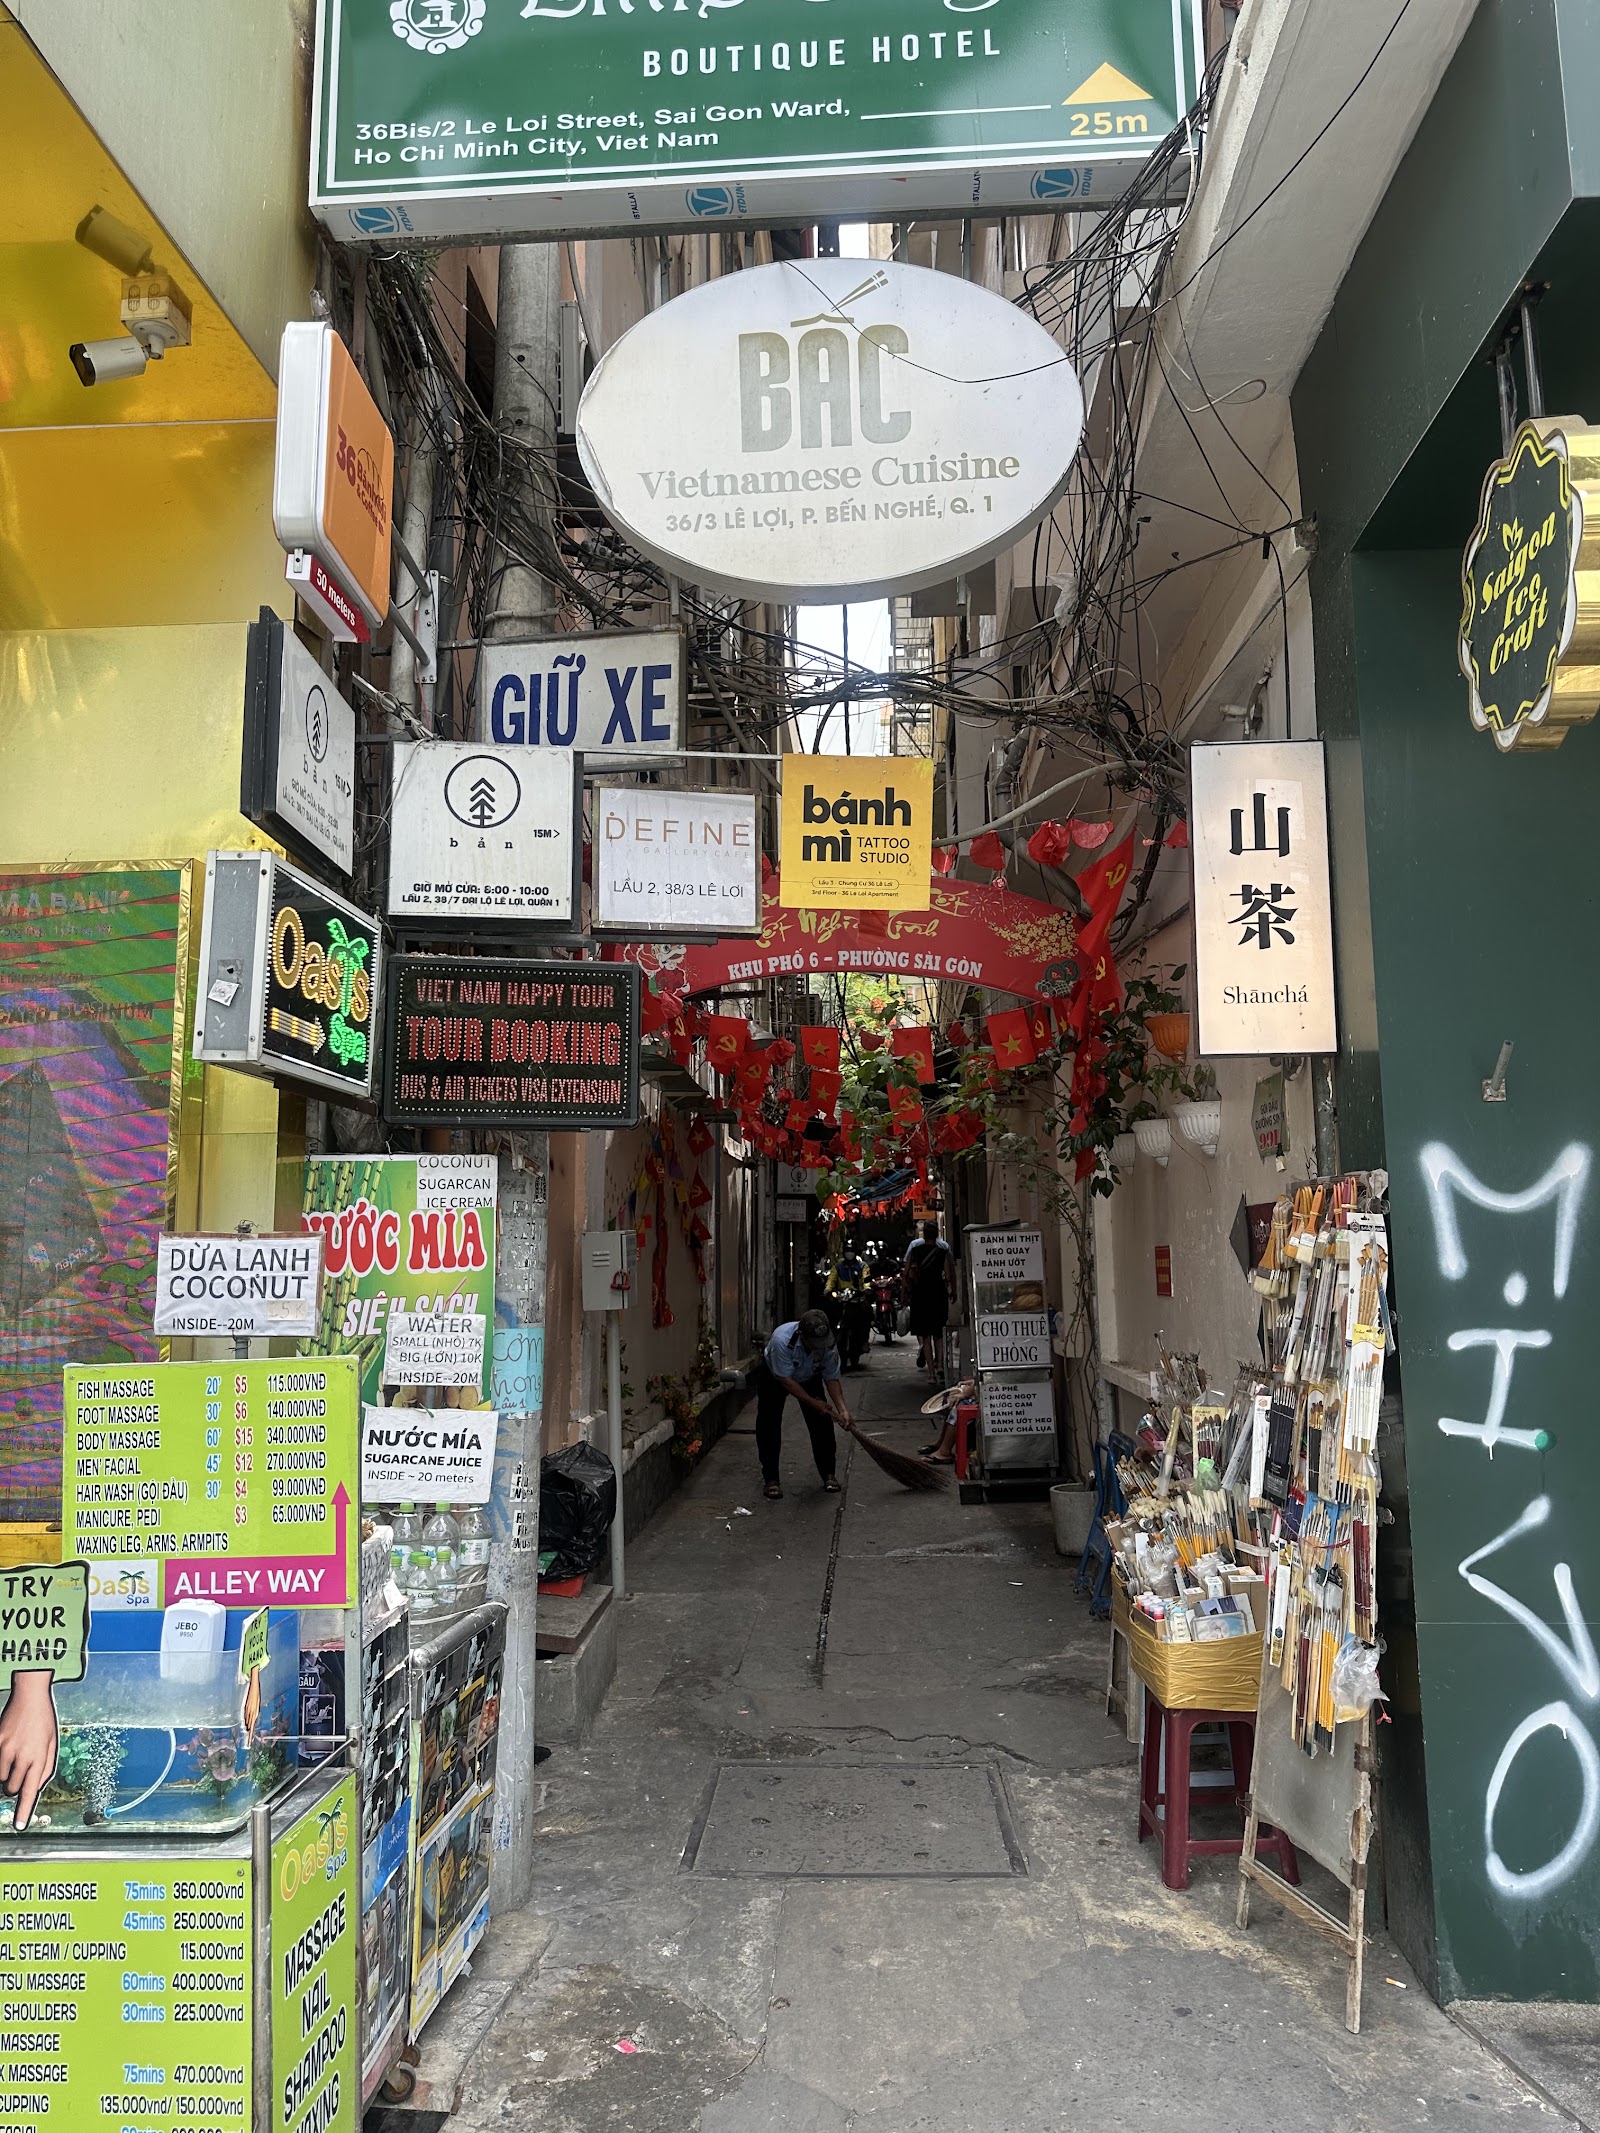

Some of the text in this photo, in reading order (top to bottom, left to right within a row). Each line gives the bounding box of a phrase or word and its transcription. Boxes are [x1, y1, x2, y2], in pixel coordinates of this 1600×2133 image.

[643, 29, 1000, 77] BOUTIQUE HOTEL
[356, 120, 456, 141] 36Bis/2
[465, 118, 496, 136] Le
[507, 113, 548, 133] Loi
[556, 109, 644, 132] Street,
[655, 106, 697, 126] Sai
[771, 98, 850, 120] Ward,
[1070, 112, 1148, 136] 25m
[355, 129, 719, 164] Ho Chi Minh City, Viet Nam
[336, 424, 356, 487] 36
[637, 453, 1020, 502] Vietnamese Cuisine
[666, 495, 993, 532] 36/3 LÊ LỢI, P. BẾN NGHÉ, Q. 1
[1481, 512, 1556, 614] Saigon
[316, 568, 356, 627] 50 meters
[1504, 572, 1540, 631] Eco
[1489, 587, 1548, 675] Craft
[490, 653, 672, 746] GIỮ XE
[803, 785, 912, 826] bánh
[533, 829, 552, 838] 15M
[605, 816, 750, 846] DEFINE
[857, 837, 910, 849] TATTOO
[643, 847, 750, 859] GALLERY CAFE
[802, 829, 851, 862] mì
[860, 852, 910, 864] STUDIO
[1228, 793, 1298, 949] 山茶
[413, 880, 432, 894] GIỜ
[519, 886, 549, 896] 10:00
[613, 878, 744, 900] LẦU 2, 38/3 LÊ LỢI
[272, 907, 370, 1022] Oasis
[728, 946, 983, 981] KHU PHỐ 6 PHƯỜNG SÀI GÒN
[416, 978, 614, 1008] VIET NAM HAPPY TOUR
[1223, 984, 1308, 1005] Shānchá
[406, 1015, 621, 1066] TOUR BOOKING
[401, 1075, 621, 1104] BUS & AIR TICKETS VISA EXTENSION
[419, 1156, 491, 1168] COCONUT
[419, 1178, 490, 1190] SUGARCAN
[427, 1197, 493, 1208] ICE CREAM
[980, 1234, 1040, 1244] BÁNH MÌ THỊT
[985, 1247, 1030, 1255] HEO QUAY
[170, 1242, 227, 1271] DỪA
[981, 1258, 1006, 1267] BÁNH
[169, 1275, 309, 1299] COCONUT
[987, 1269, 1025, 1280] CHẢ LỤA
[408, 1317, 472, 1333] WATER
[981, 1316, 1047, 1337] CHO THUÊ
[392, 1334, 482, 1349] SMALL (NHỎ) 7K
[993, 1342, 1038, 1363] PHÒNG
[400, 1351, 482, 1365] BIG (LỚN) 10K
[77, 1373, 326, 1399] FISH MASSAGE 20' $5 115.000VNĐ
[77, 1425, 326, 1451] BODY MASSAGE 60' $15 340.000VNĐ
[368, 1426, 482, 1450] NƯỚC MÍA
[364, 1453, 482, 1467] SUGARCANE JUICE
[368, 1470, 474, 1483] INSIDE 20 meters
[4, 1576, 54, 1598] TRY
[174, 1569, 326, 1595] ALLEY WAY
[1, 1606, 65, 1630] YOUR
[175, 1622, 198, 1631] JEBO
[2, 1638, 68, 1663] HAND
[280, 1805, 349, 1901] Oasis
[326, 1848, 347, 1882] Spa
[3, 1881, 244, 1900] FOOT MASSAGE 75mins 360.000vnd
[284, 1891, 346, 1998] MASSAGE
[4, 2003, 244, 2022] SHOULDERS 30mins 225.000vnd
[302, 1970, 331, 2038] NAIL
[283, 2004, 346, 2124] SHAMPOO
